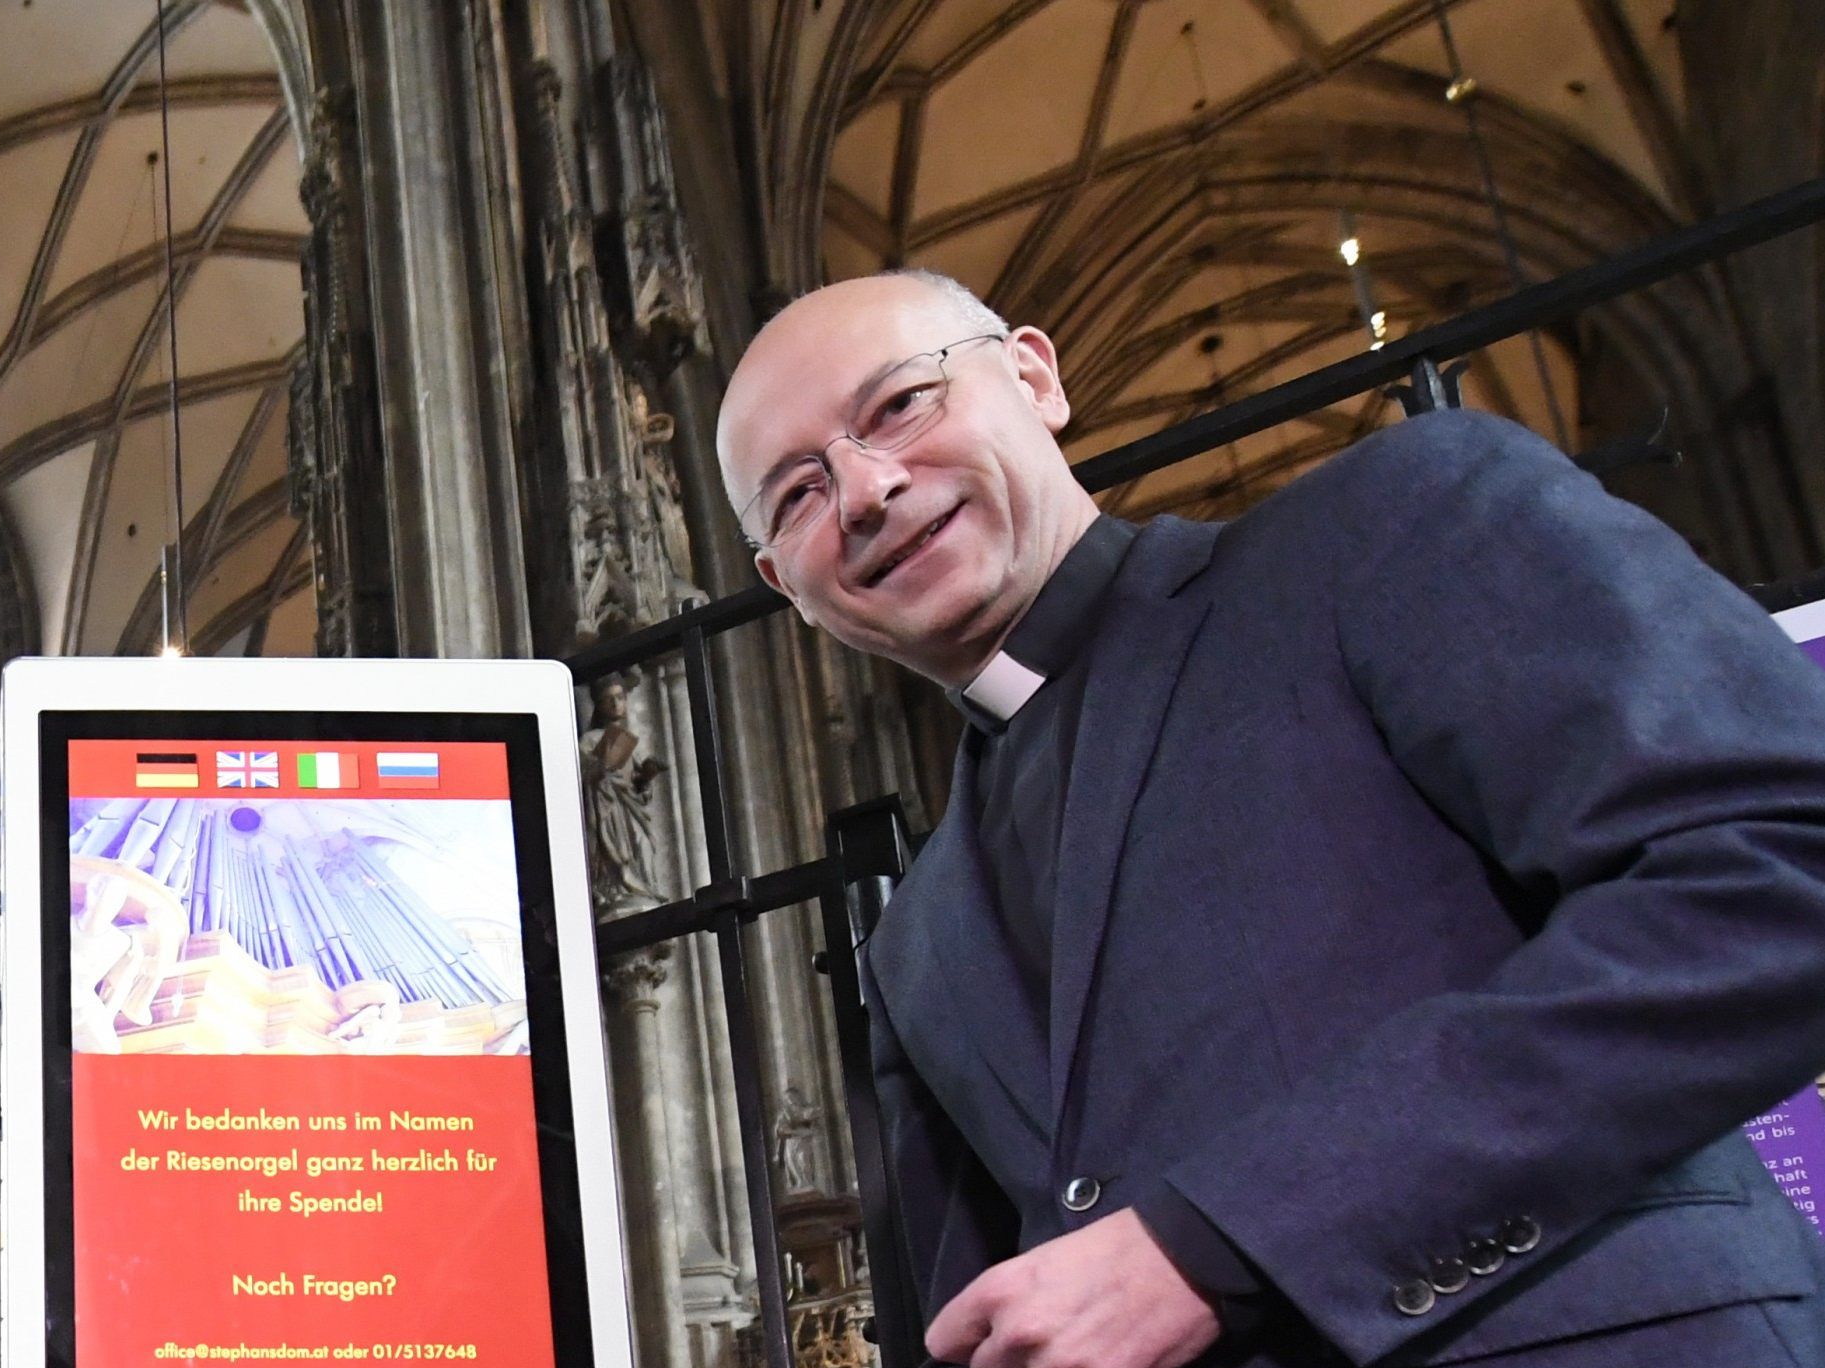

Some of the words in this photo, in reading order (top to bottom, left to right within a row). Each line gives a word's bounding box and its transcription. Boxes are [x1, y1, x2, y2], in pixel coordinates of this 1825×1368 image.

[137, 1109, 179, 1131] Wir
[185, 1107, 300, 1131] bedanken
[308, 1114, 348, 1132] uns
[354, 1111, 382, 1131] im
[389, 1110, 474, 1132] Namen
[1771, 1126, 1796, 1138] bis
[120, 1147, 160, 1171] der
[166, 1148, 298, 1177] Riesenorgel
[306, 1155, 365, 1178] ganz
[371, 1148, 459, 1172] herzlich
[466, 1148, 498, 1172] für
[1783, 1155, 1804, 1167] an
[238, 1188, 282, 1213] ihre
[289, 1189, 383, 1218] Spende!
[232, 1271, 295, 1296] Noch
[303, 1273, 397, 1301] Fragen?
[154, 1342, 329, 1362] office@stephansdom.at
[333, 1343, 369, 1360] oder
[372, 1342, 477, 1362] 01/5137648
